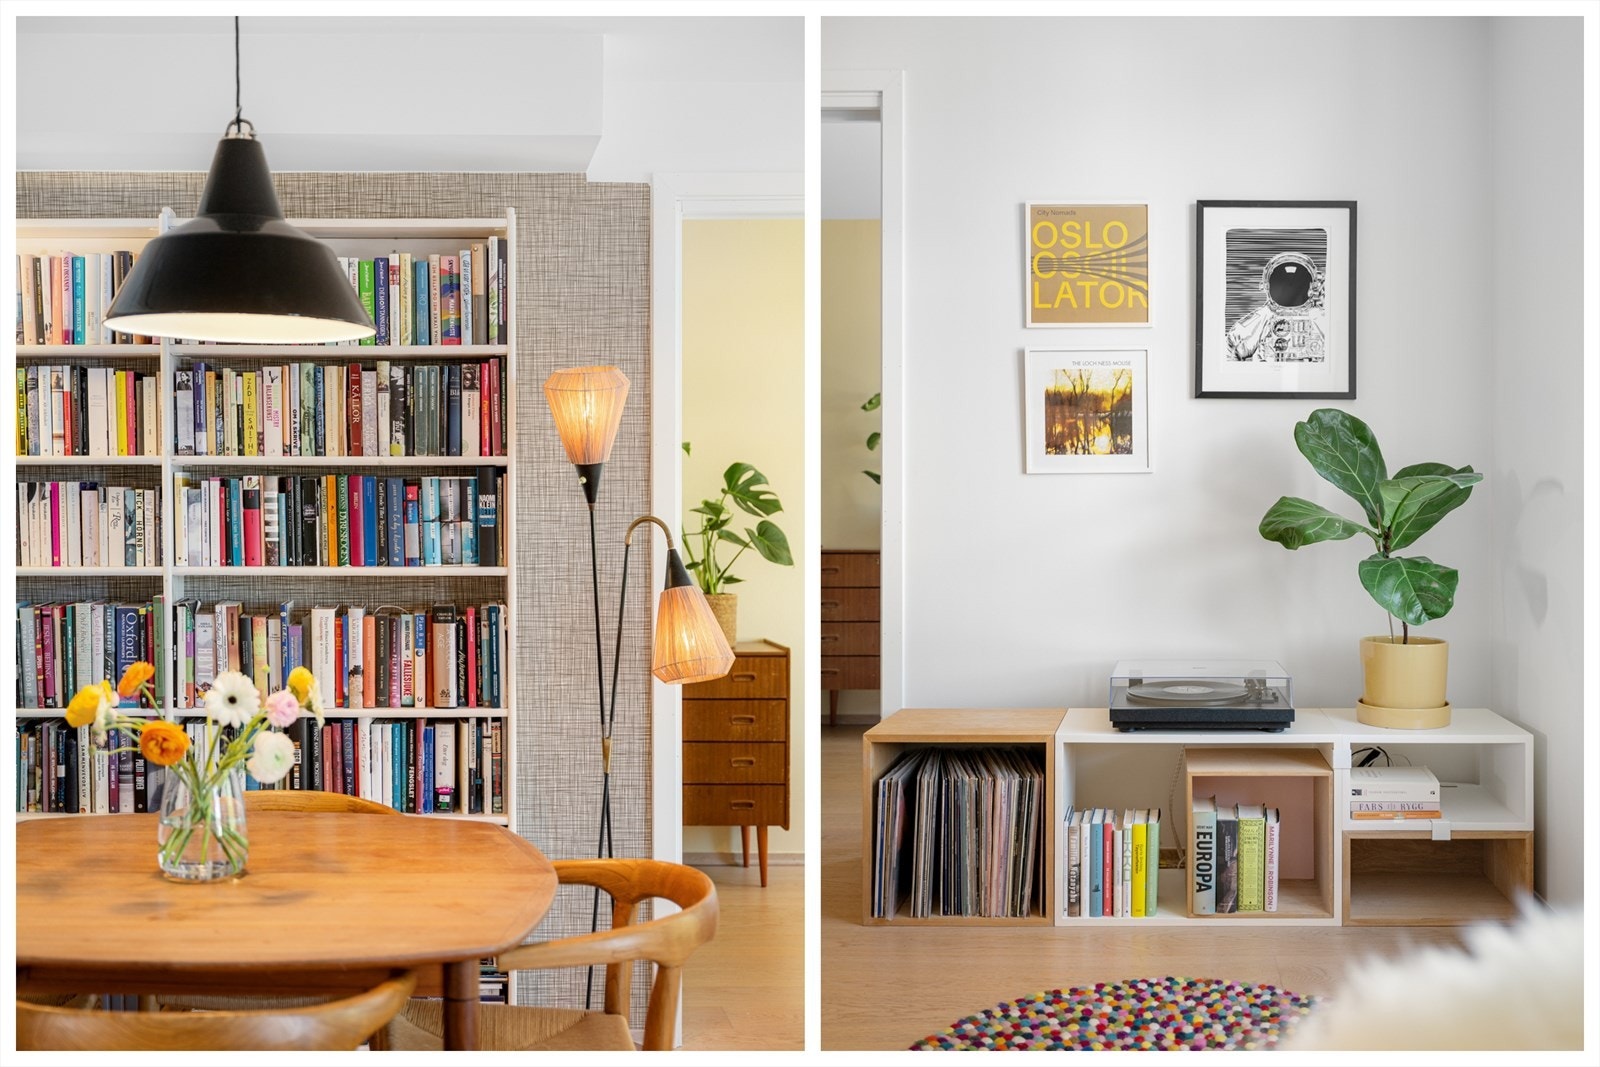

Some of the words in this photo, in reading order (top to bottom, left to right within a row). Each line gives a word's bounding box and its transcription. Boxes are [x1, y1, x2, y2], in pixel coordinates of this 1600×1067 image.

[1032, 220, 1128, 249] OSLO
[1034, 281, 1148, 308] LATOR
[340, 512, 348, 562] DYRESKOGEN
[126, 612, 138, 658] Oxford
[404, 660, 412, 696] FALLESJUKE
[344, 723, 354, 740] BEN
[345, 742, 354, 764] OKRI
[1196, 832, 1212, 893] EUROPA
[1070, 866, 1079, 903] Netanyahu
